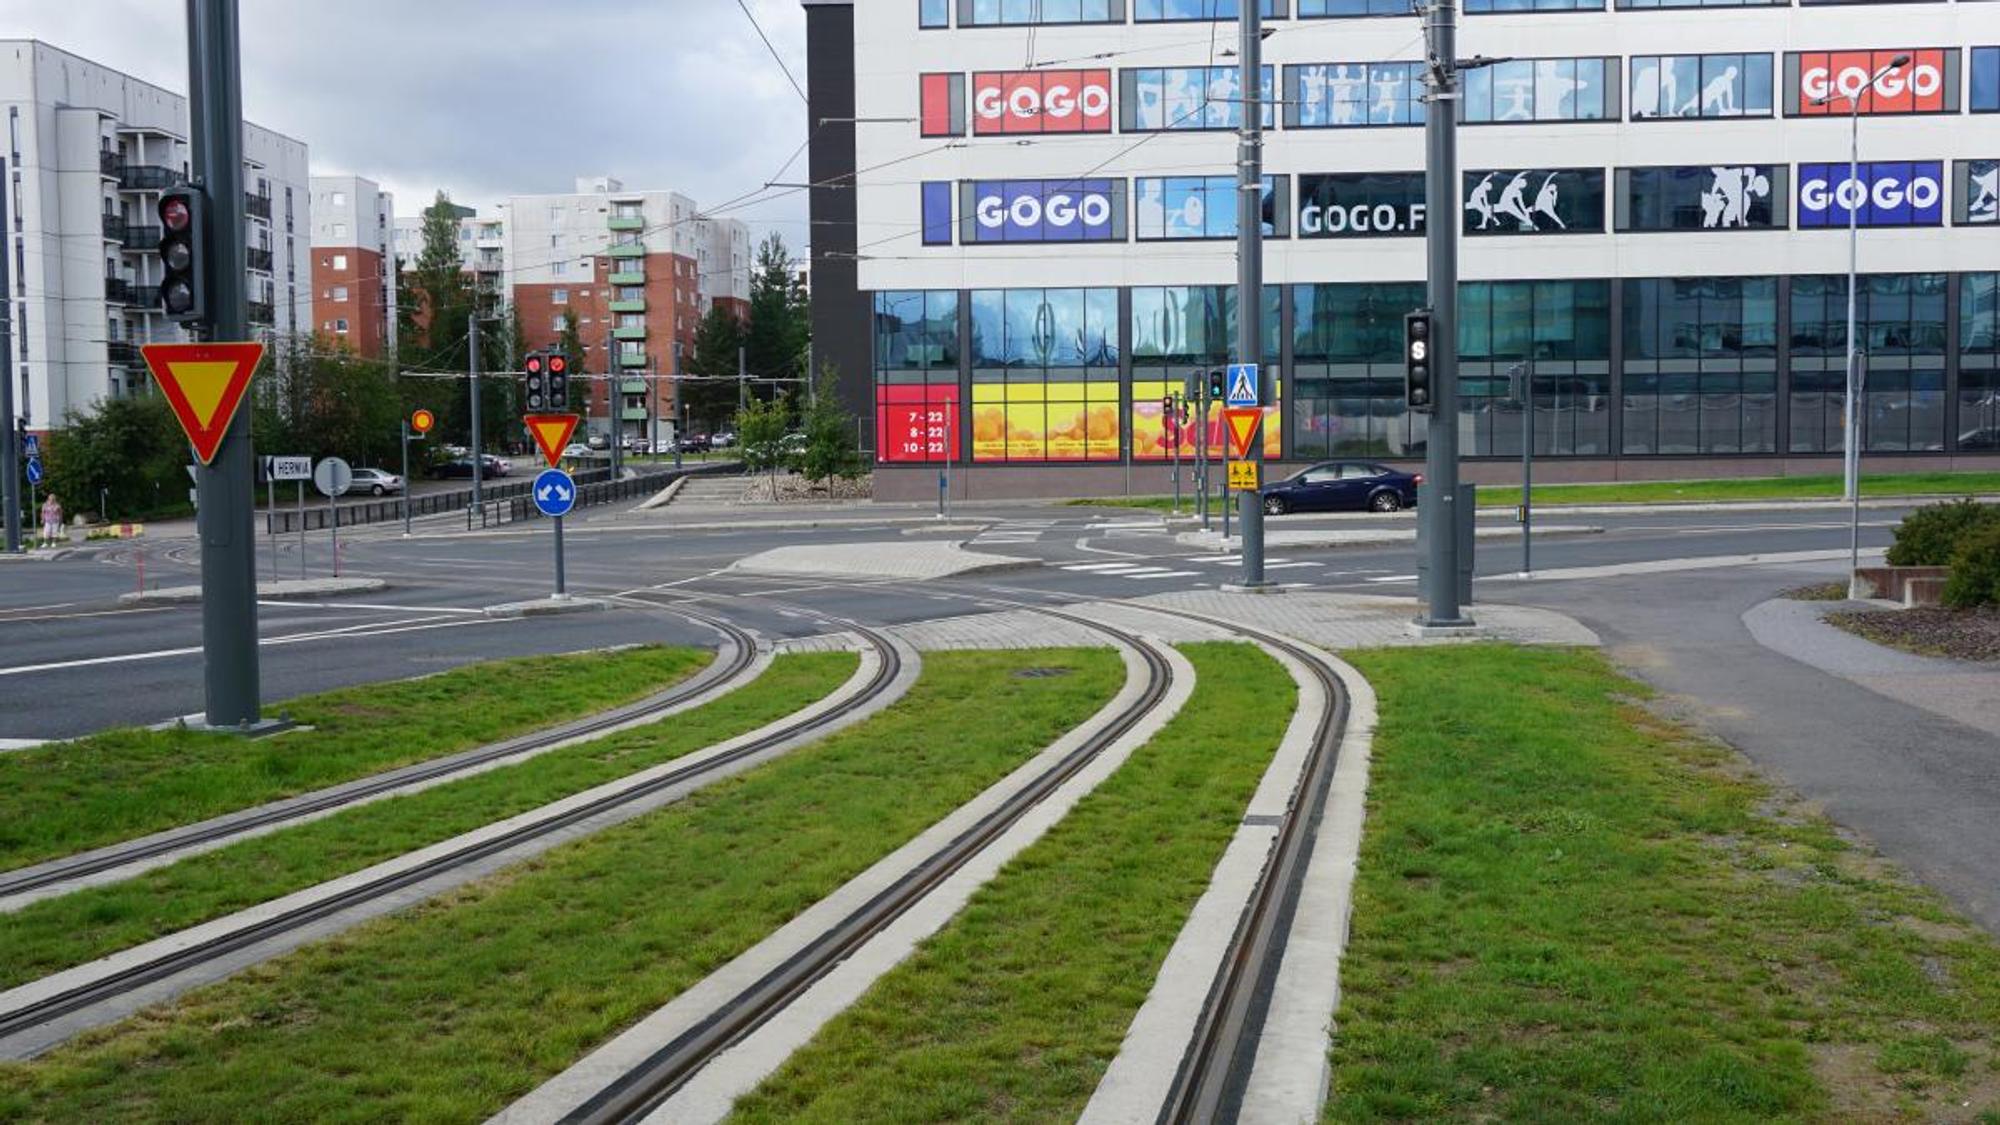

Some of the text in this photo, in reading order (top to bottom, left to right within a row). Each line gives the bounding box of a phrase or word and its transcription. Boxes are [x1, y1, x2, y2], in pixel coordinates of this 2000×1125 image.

[1802, 65, 1940, 98] GOGO
[976, 86, 1109, 119] GOGO
[1801, 177, 1939, 211] GOGO
[977, 194, 1109, 228] GOGO
[1301, 204, 1426, 232] GOGO.F
[909, 412, 917, 422] 7
[928, 411, 943, 422] 22
[928, 427, 943, 438] 22
[903, 442, 918, 453] 10
[928, 442, 943, 453] 22
[278, 461, 308, 475] HERMIA
